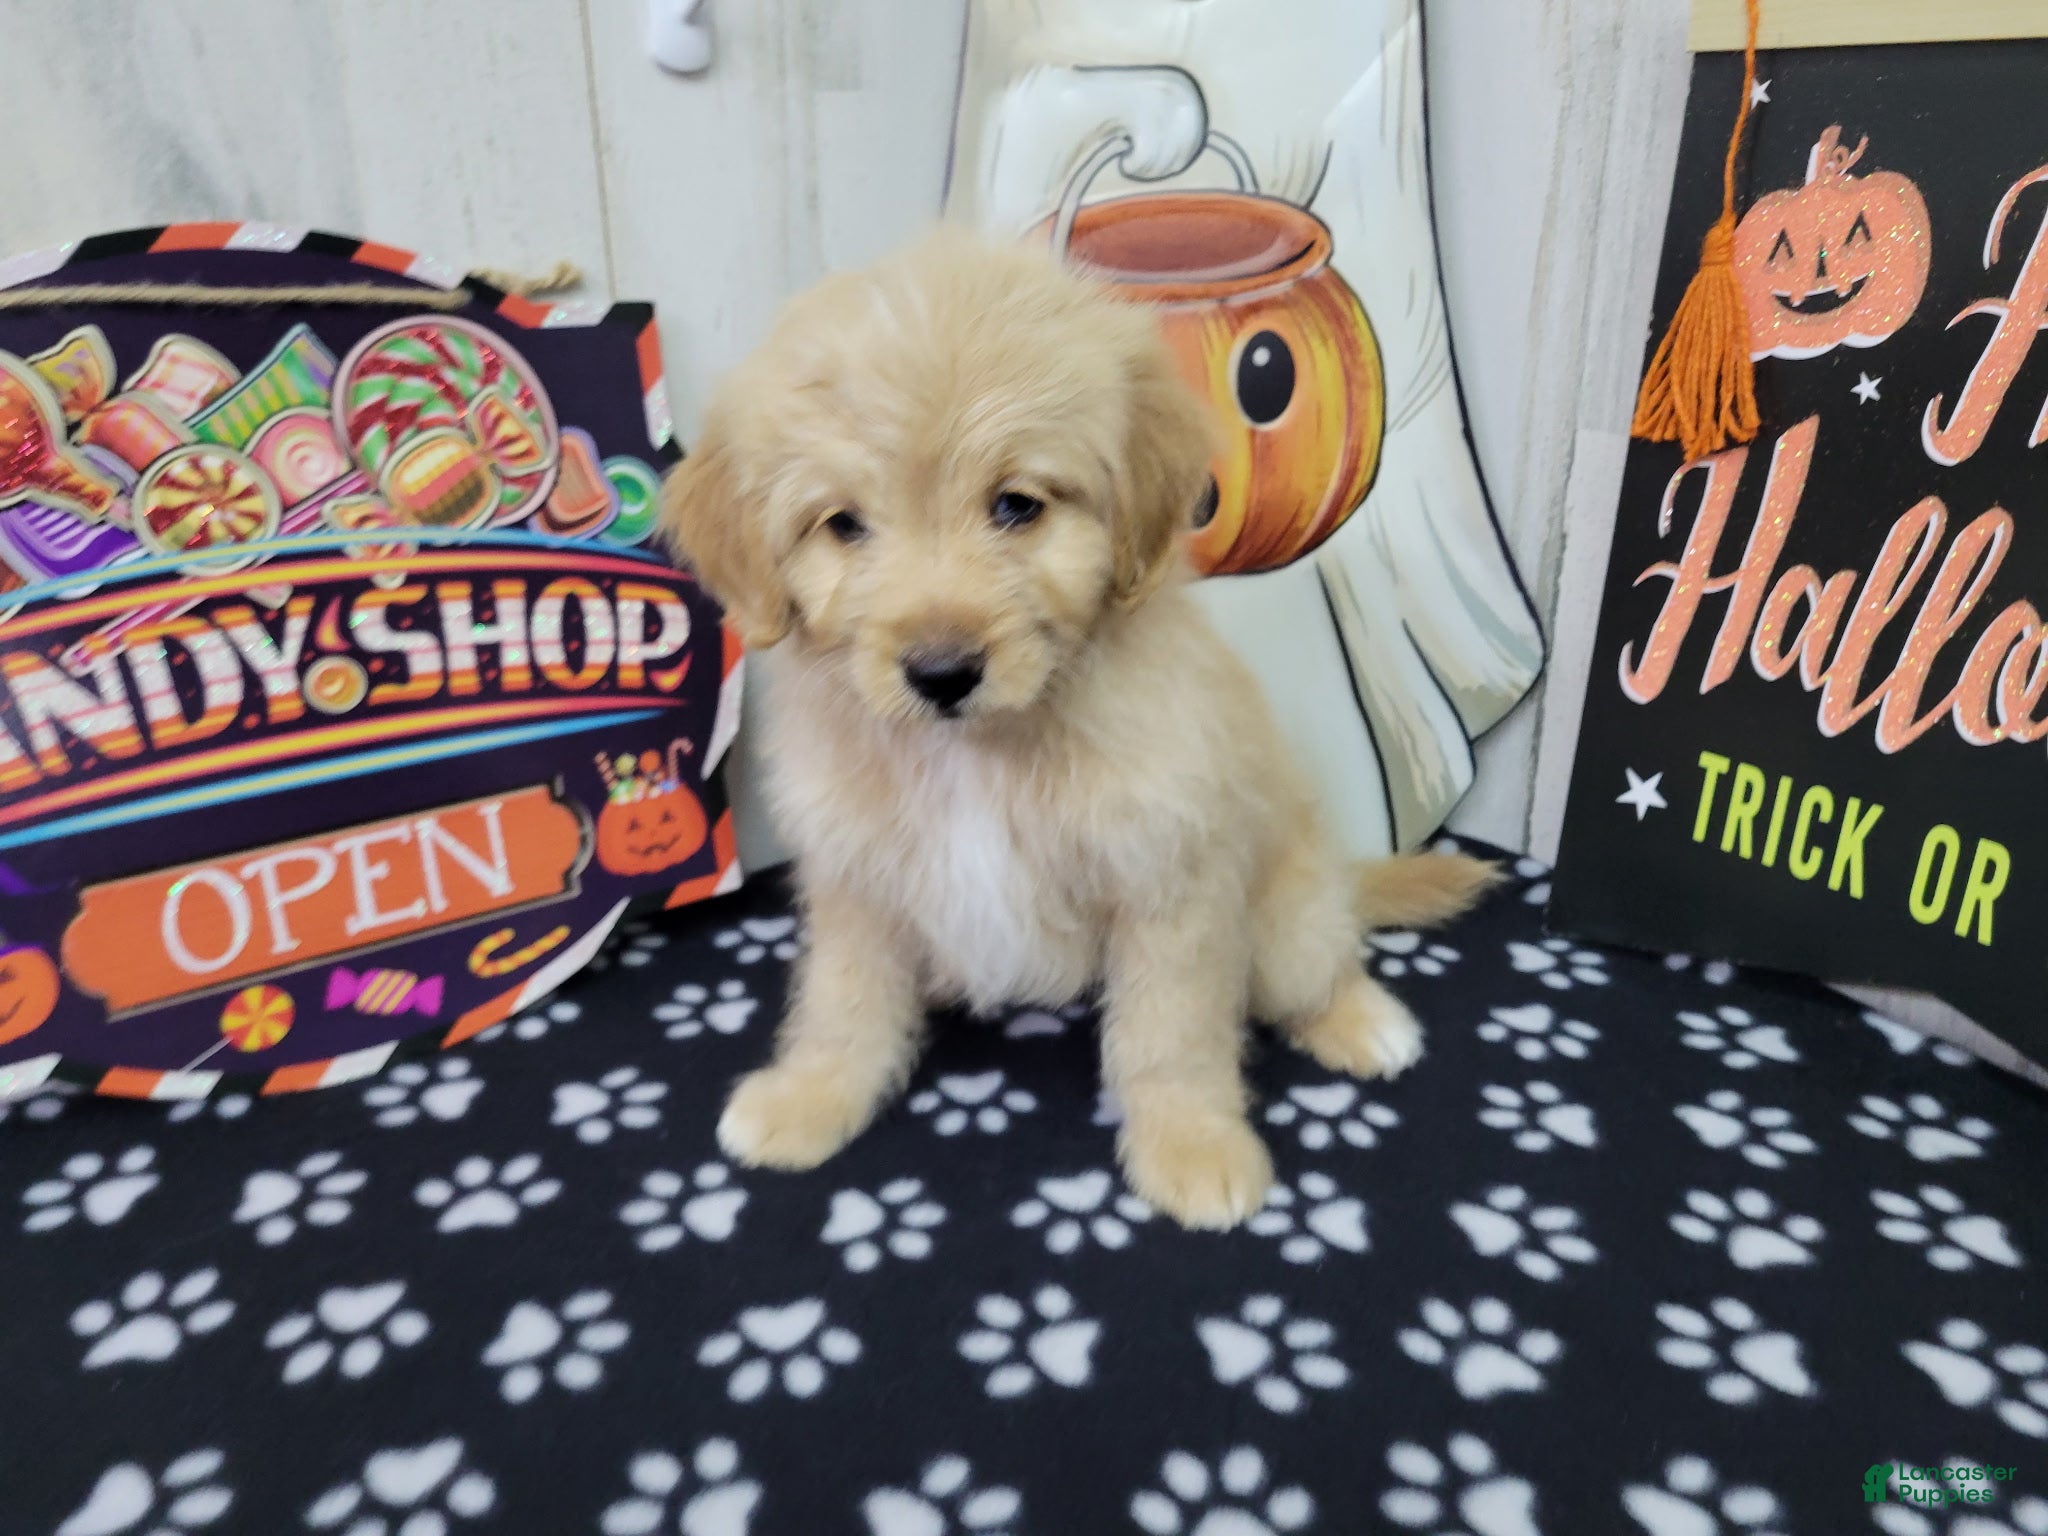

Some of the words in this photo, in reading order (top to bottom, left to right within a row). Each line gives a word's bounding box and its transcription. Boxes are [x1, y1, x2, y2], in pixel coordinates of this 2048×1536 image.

[349, 576, 691, 706] SHOP
[161, 802, 515, 974] OPEN
[1692, 750, 1885, 900] TRICK
[1908, 824, 2011, 947] OR
